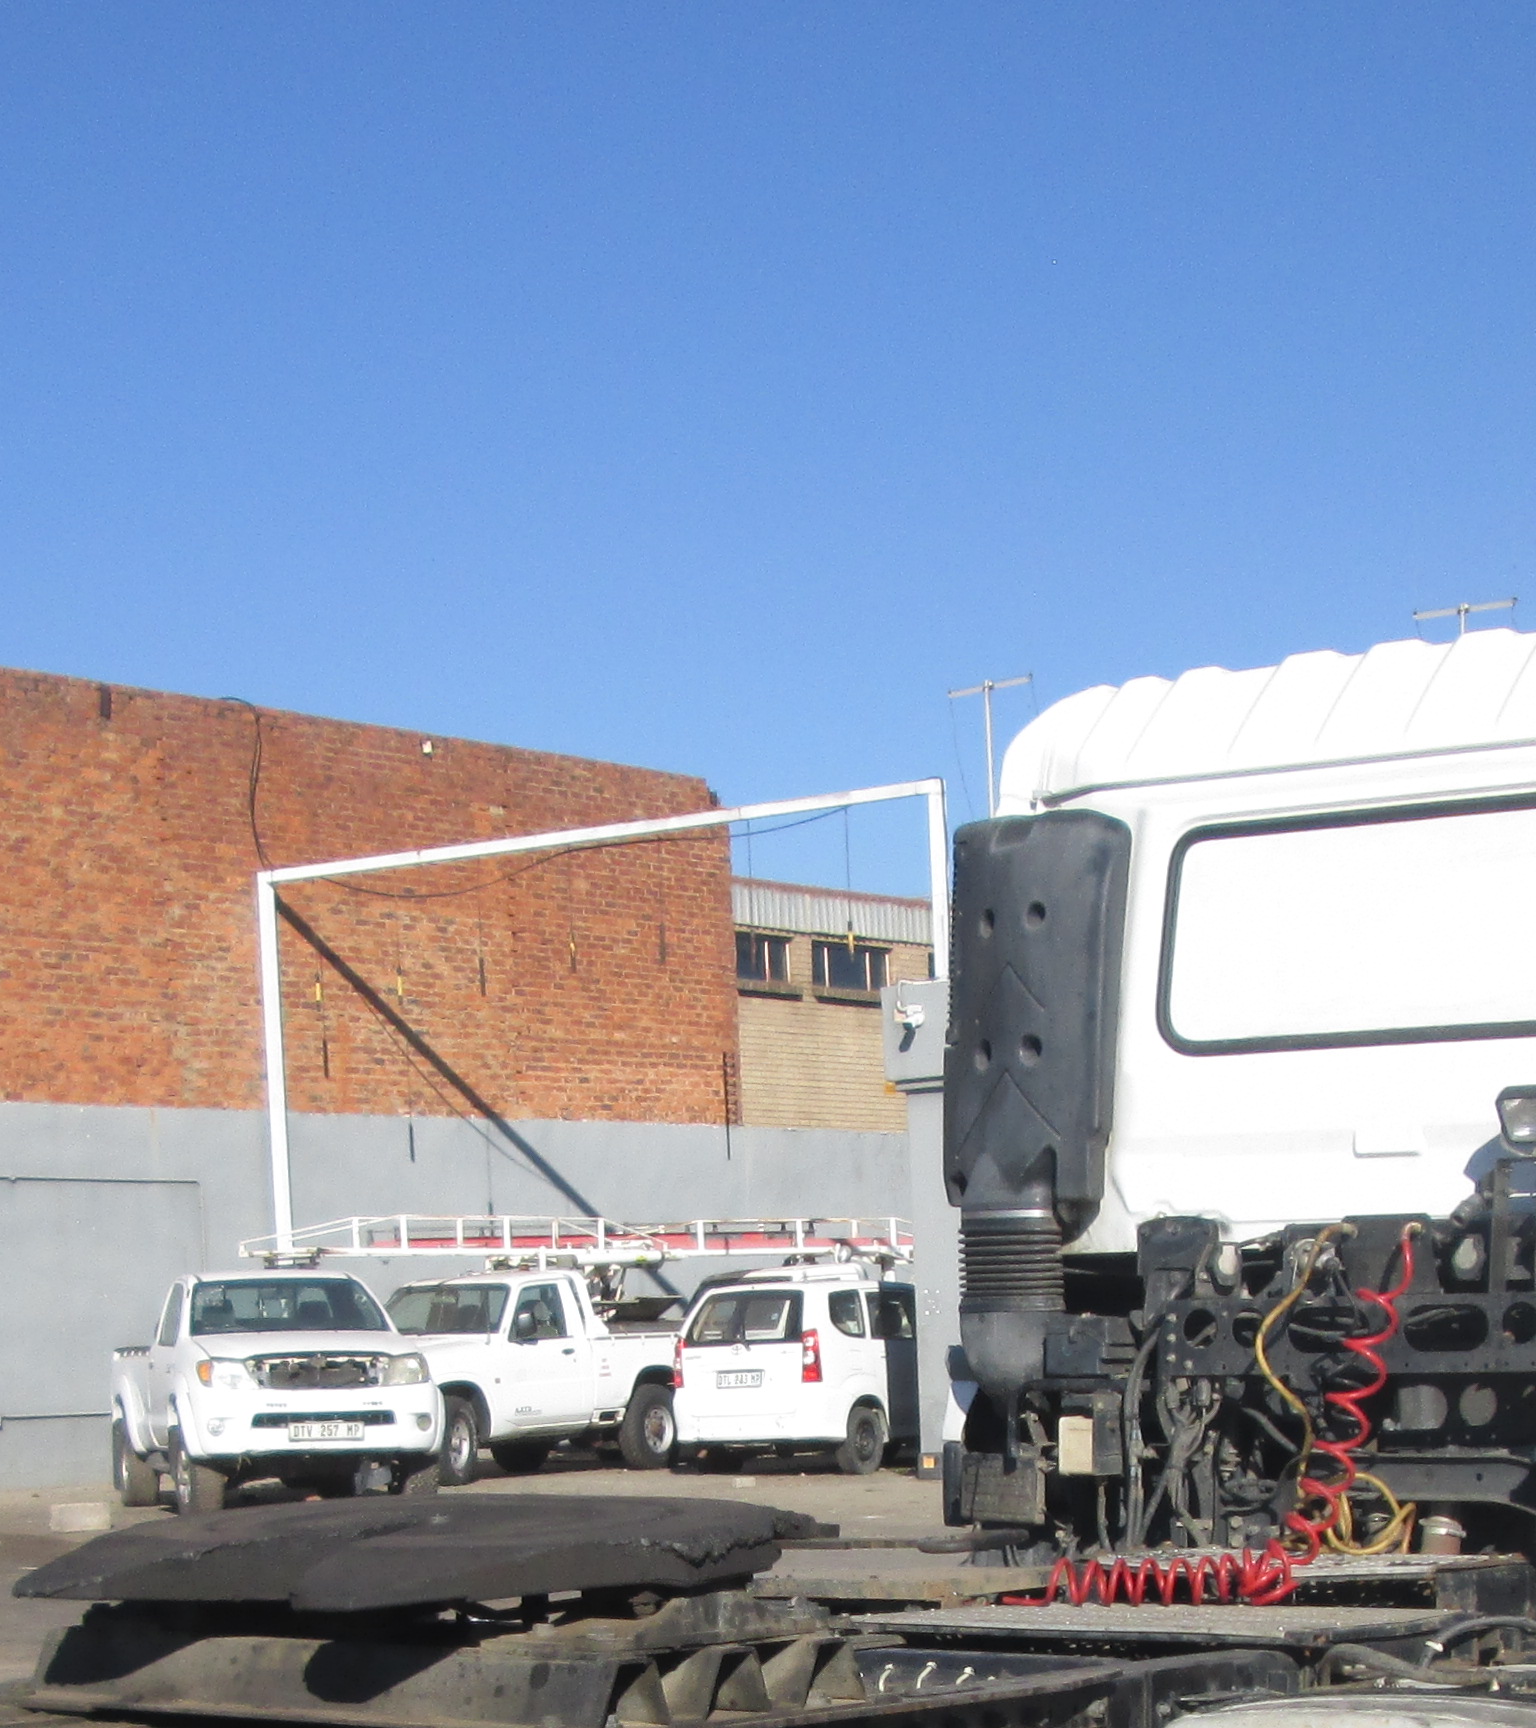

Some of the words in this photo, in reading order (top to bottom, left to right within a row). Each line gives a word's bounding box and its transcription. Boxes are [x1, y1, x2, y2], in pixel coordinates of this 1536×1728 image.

[293, 1425, 313, 1438] DTV
[320, 1424, 340, 1437] 257
[346, 1424, 360, 1437] MP
